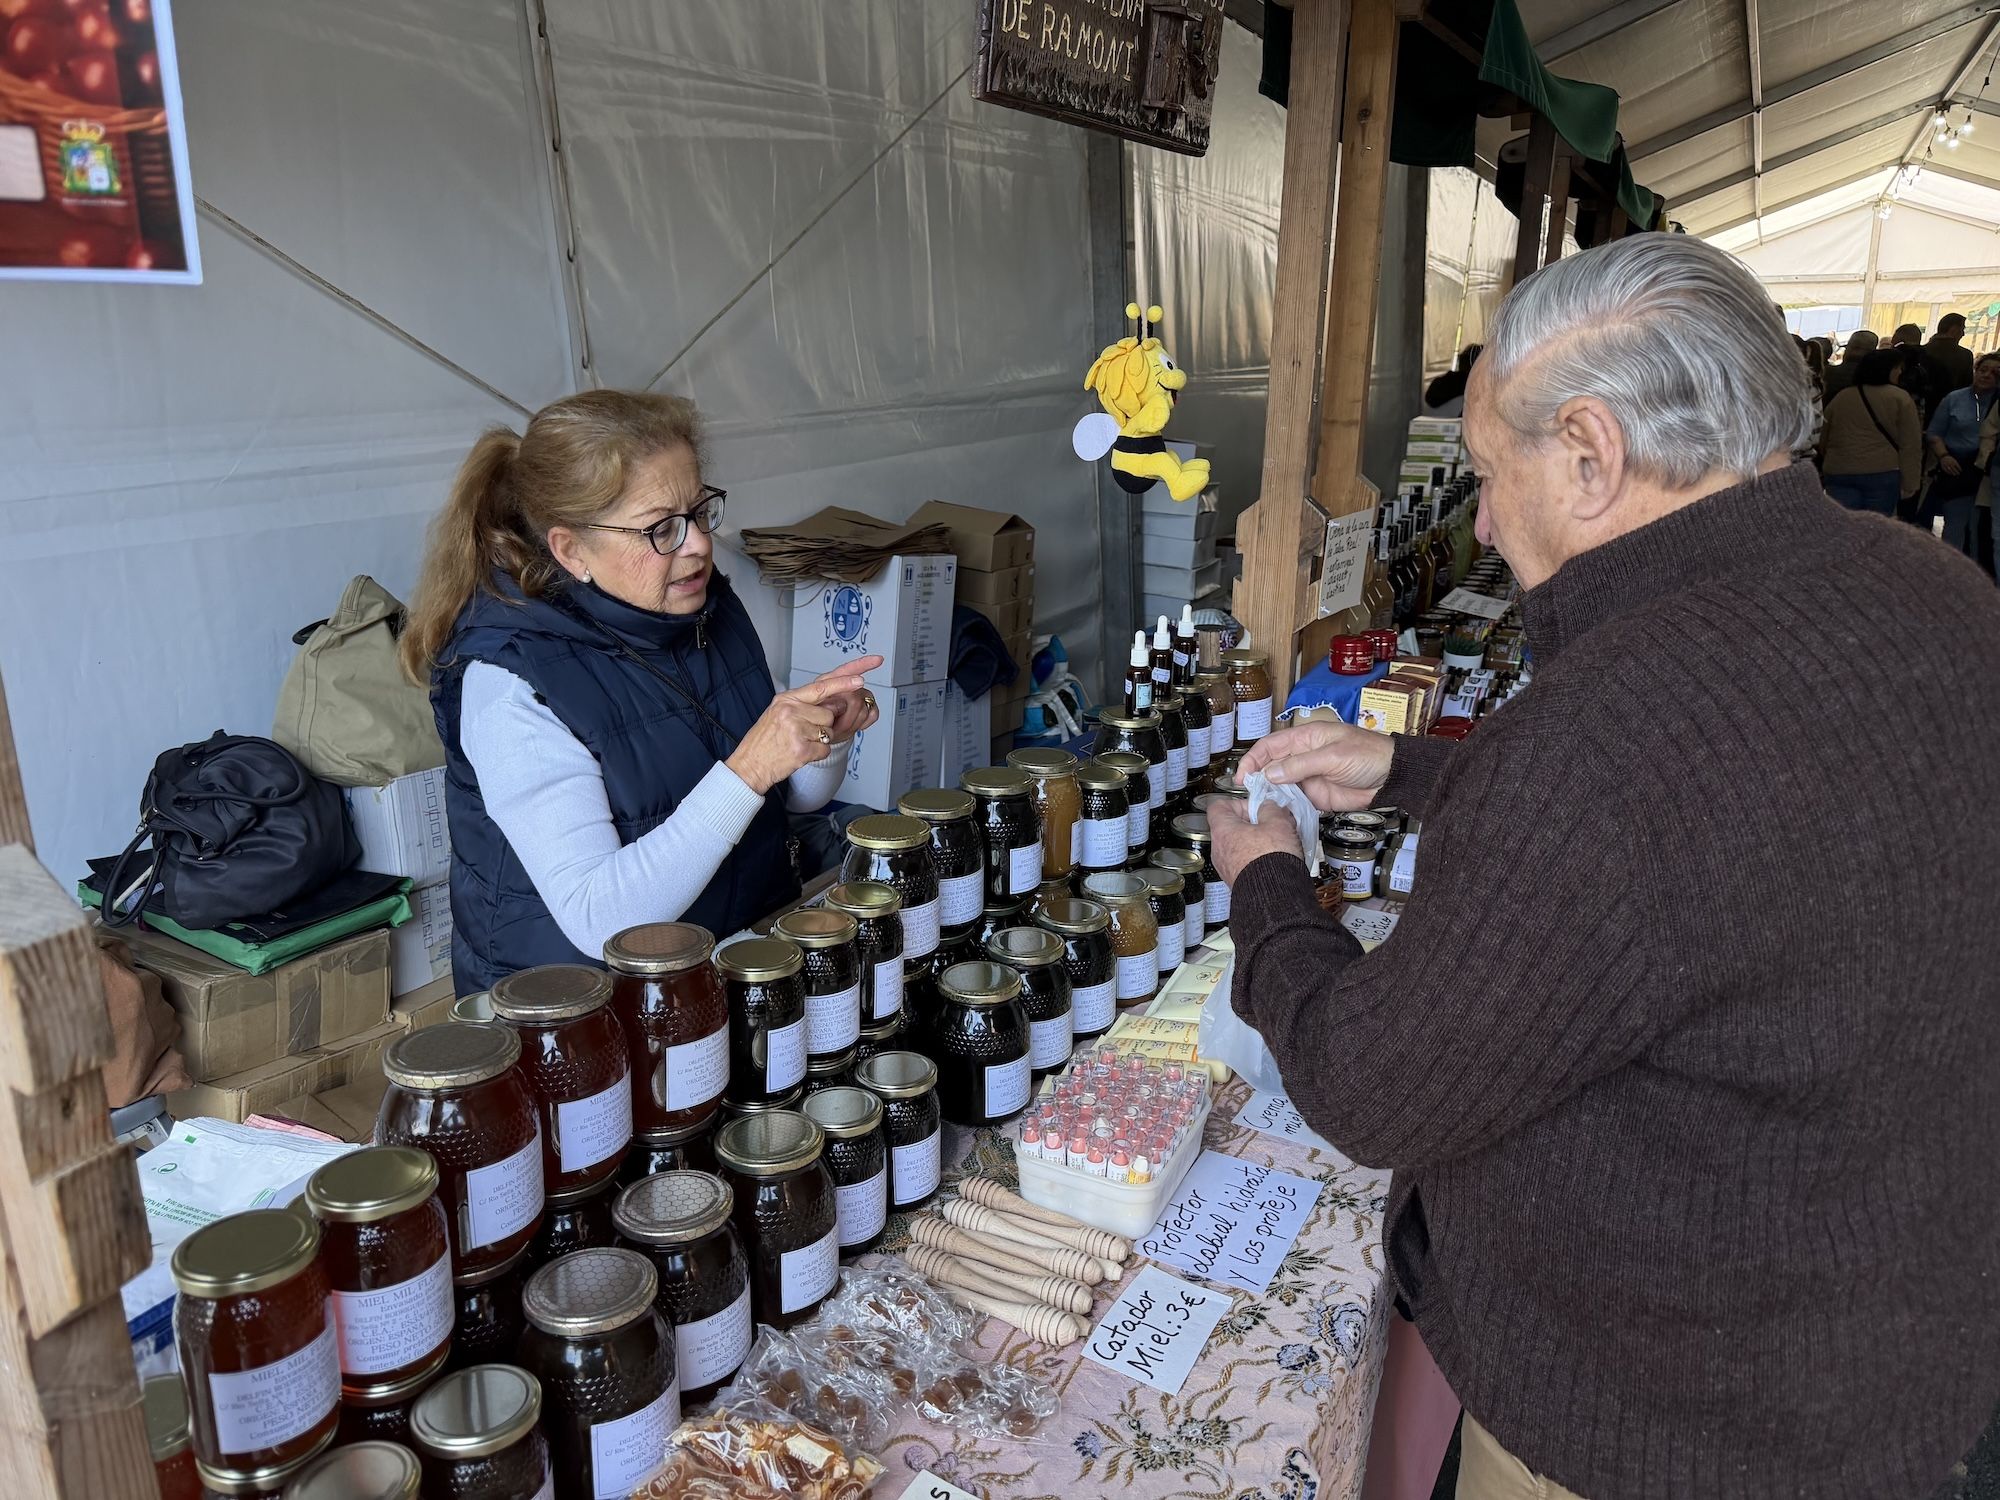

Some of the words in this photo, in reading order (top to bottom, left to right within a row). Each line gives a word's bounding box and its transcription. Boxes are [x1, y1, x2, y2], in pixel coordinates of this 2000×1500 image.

[1001, 0, 1032, 40] DE
[694, 1040, 711, 1051] MIEL
[1144, 1189, 1208, 1256] Protector
[1255, 1183, 1297, 1242] proteje
[358, 1295, 389, 1308] MIEL
[393, 1286, 415, 1301] MIL
[1093, 1289, 1157, 1362] Catador
[371, 1341, 400, 1354] PESO
[404, 1325, 431, 1345] NETO
[251, 1368, 284, 1383] MIEL
[263, 1411, 294, 1428] PESO
[630, 1411, 650, 1426] MIEL
[654, 1467, 679, 1493] Miel
